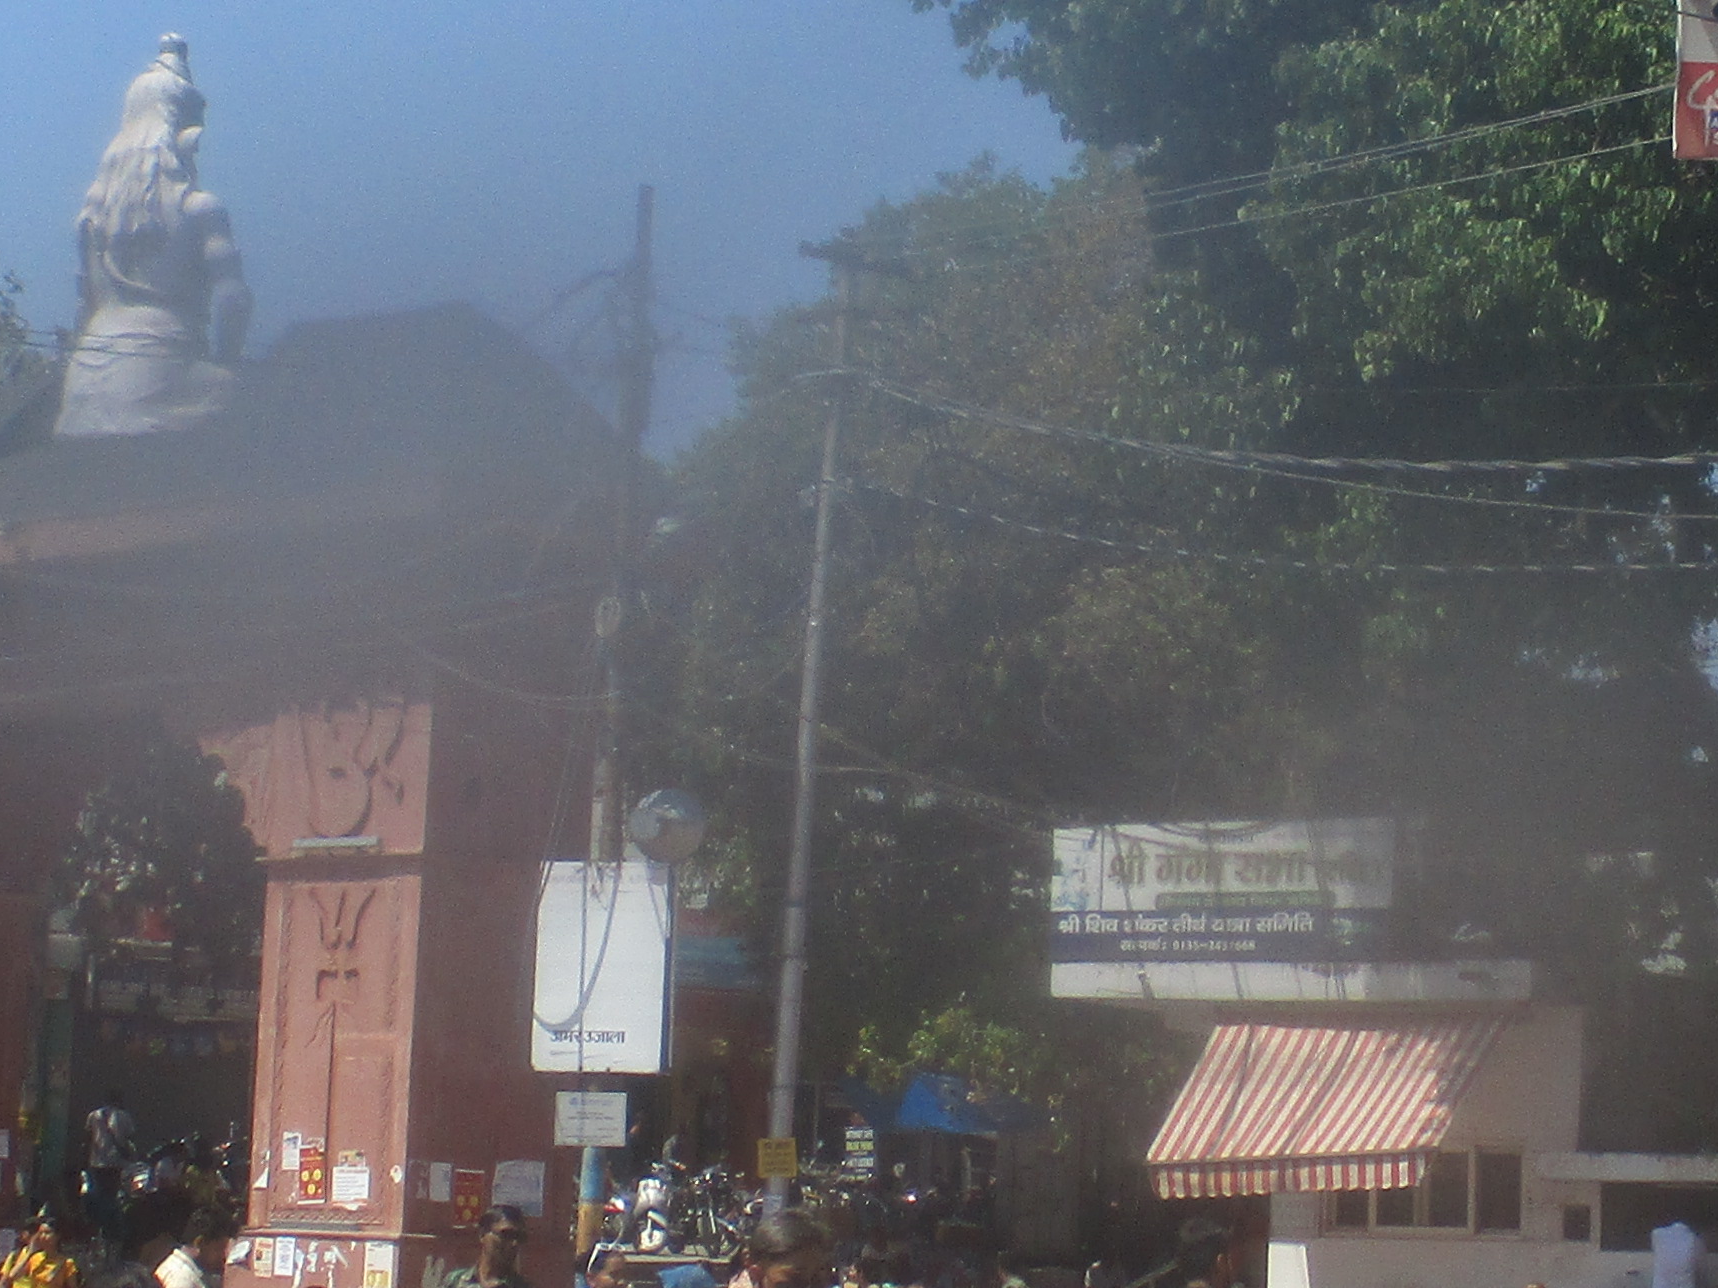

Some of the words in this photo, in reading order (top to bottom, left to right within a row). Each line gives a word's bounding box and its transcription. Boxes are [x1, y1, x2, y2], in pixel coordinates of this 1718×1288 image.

[1058, 914, 1082, 936] श्री
[1085, 912, 1119, 935] शिव
[1255, 910, 1315, 934] समिति
[583, 1029, 627, 1045] उजाला
